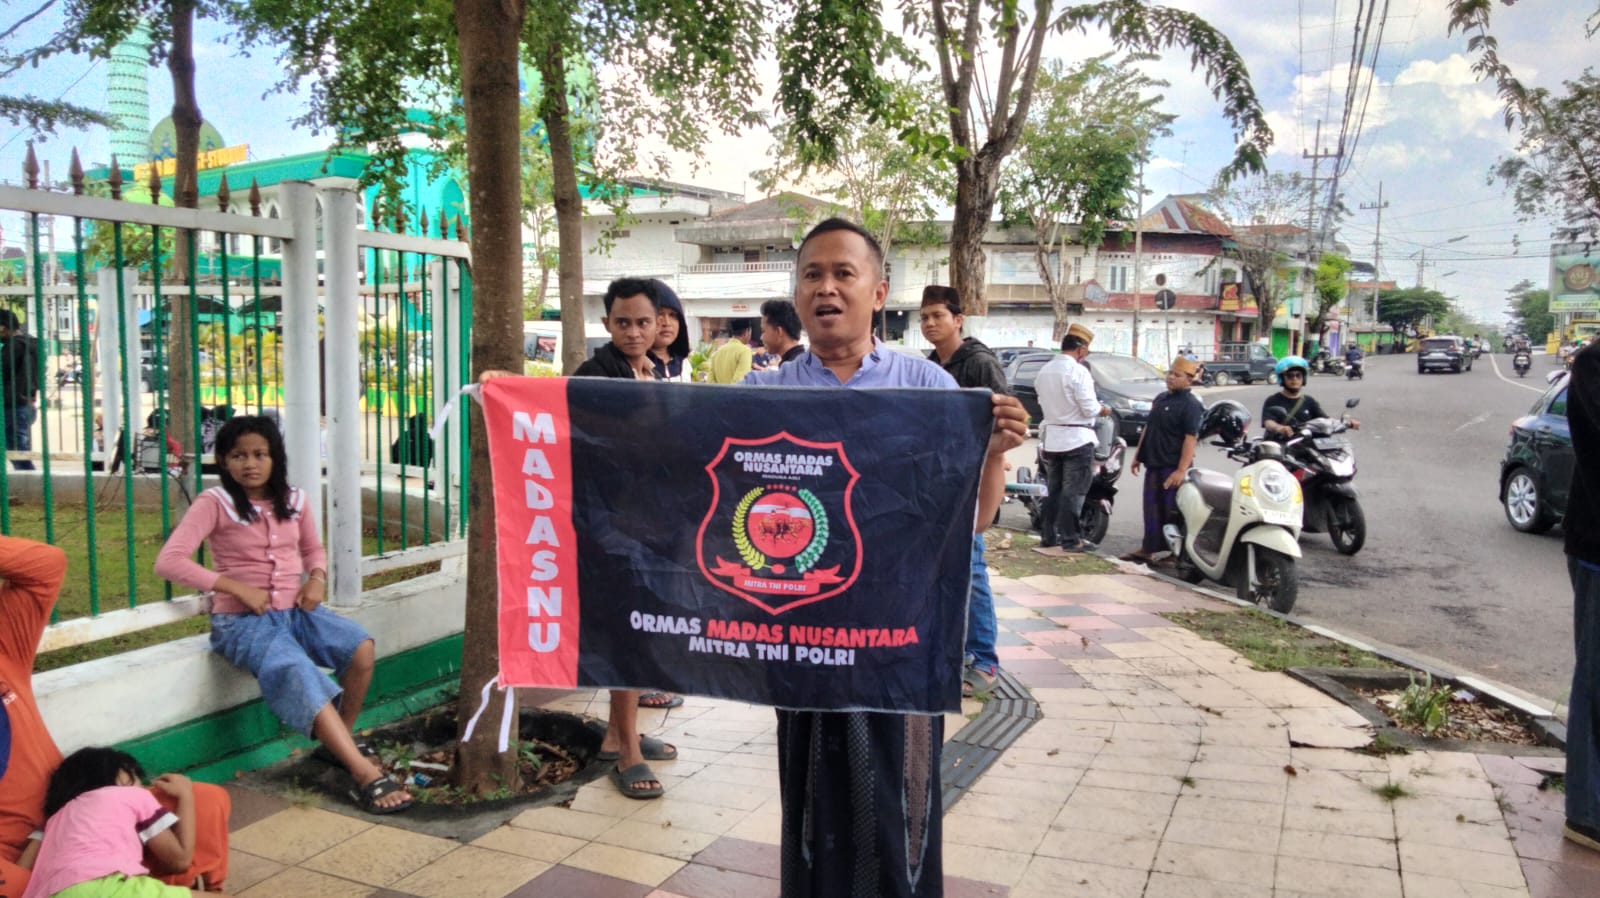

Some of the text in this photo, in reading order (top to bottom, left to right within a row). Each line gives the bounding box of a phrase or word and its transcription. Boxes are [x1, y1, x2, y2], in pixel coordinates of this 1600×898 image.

[734, 451, 833, 466] ORMAS MADAS
[743, 462, 823, 476] NUSANTARA
[512, 411, 562, 653] MADASNU
[744, 580, 767, 588] MITRA
[783, 584, 806, 592] POLRI
[630, 610, 919, 648] ORMAS MADAS NUSANTARA
[688, 636, 855, 666] MITRA TNI POLRI
